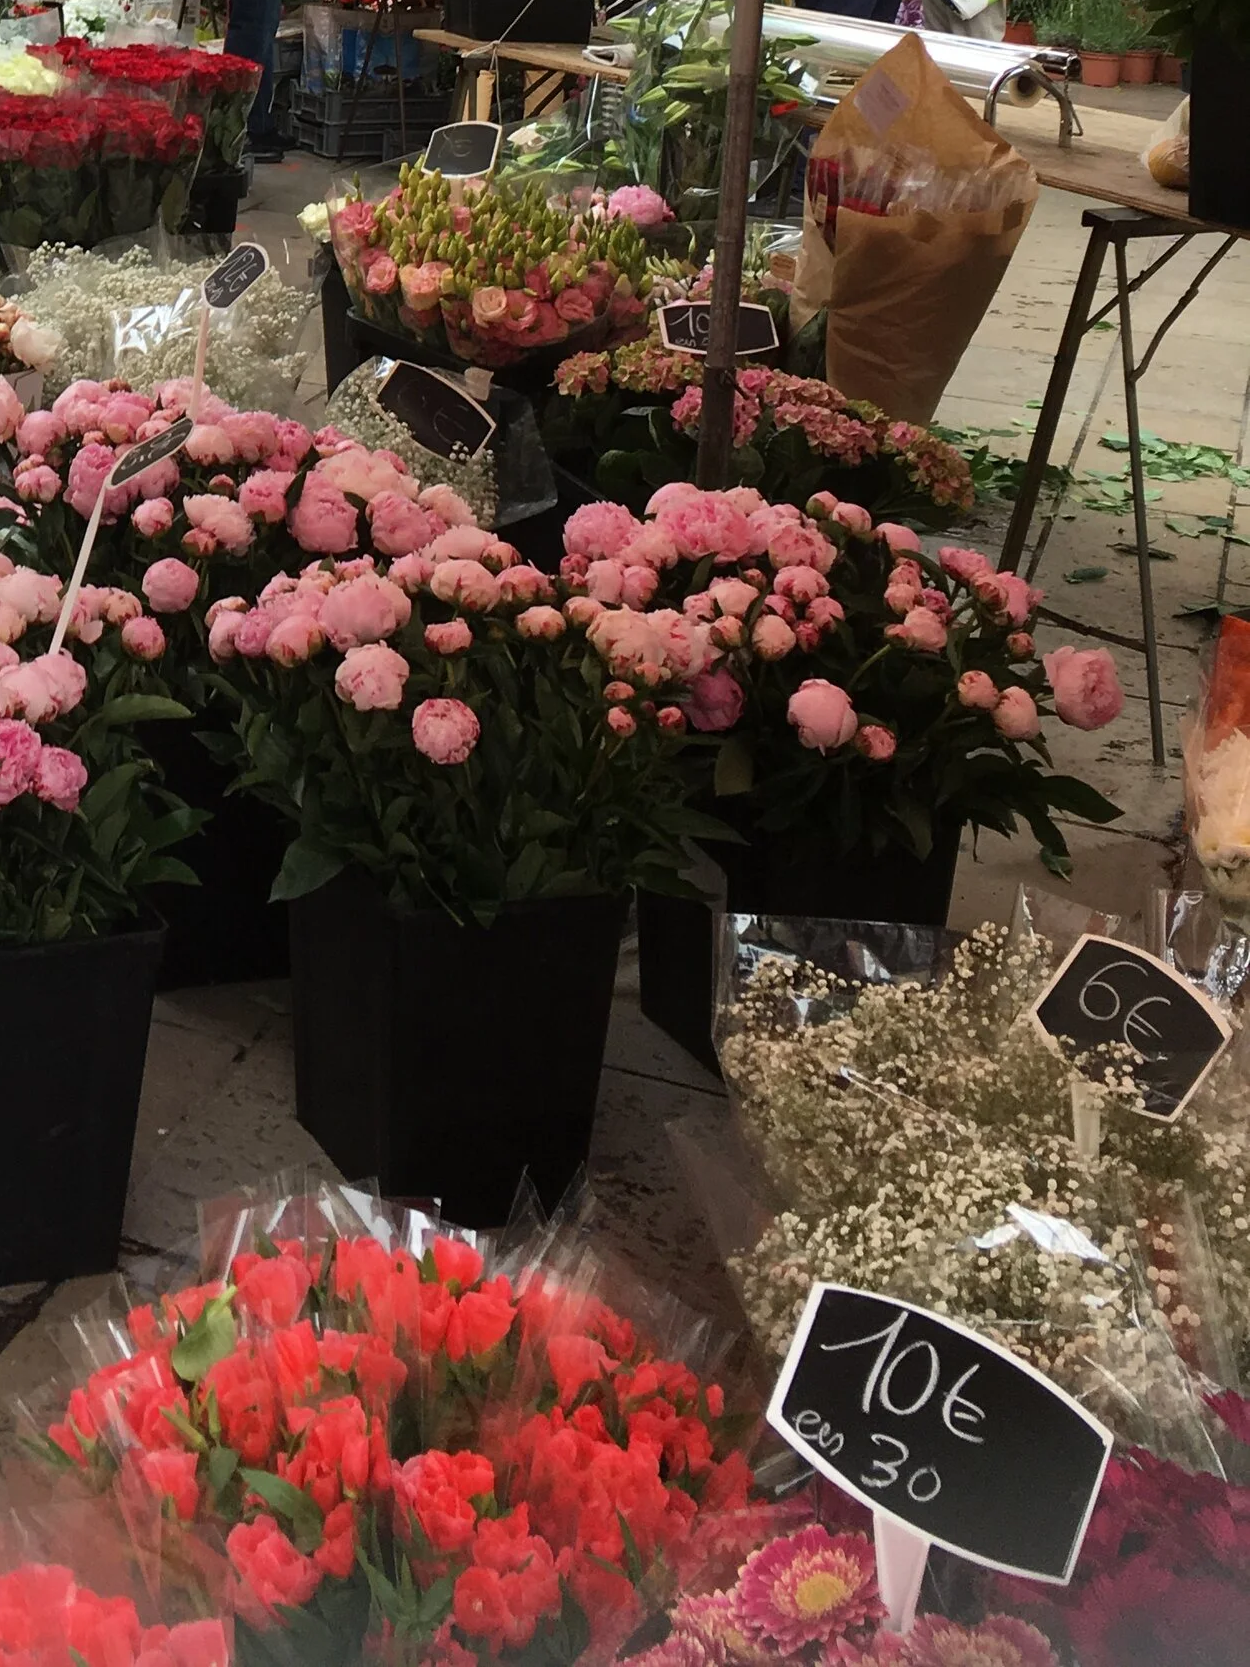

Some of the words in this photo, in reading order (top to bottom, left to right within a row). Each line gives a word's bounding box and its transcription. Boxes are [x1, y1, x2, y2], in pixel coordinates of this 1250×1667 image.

[1078, 961, 1172, 1062] 6€
[821, 1310, 986, 1444] 10€
[861, 1434, 942, 1502] 30
